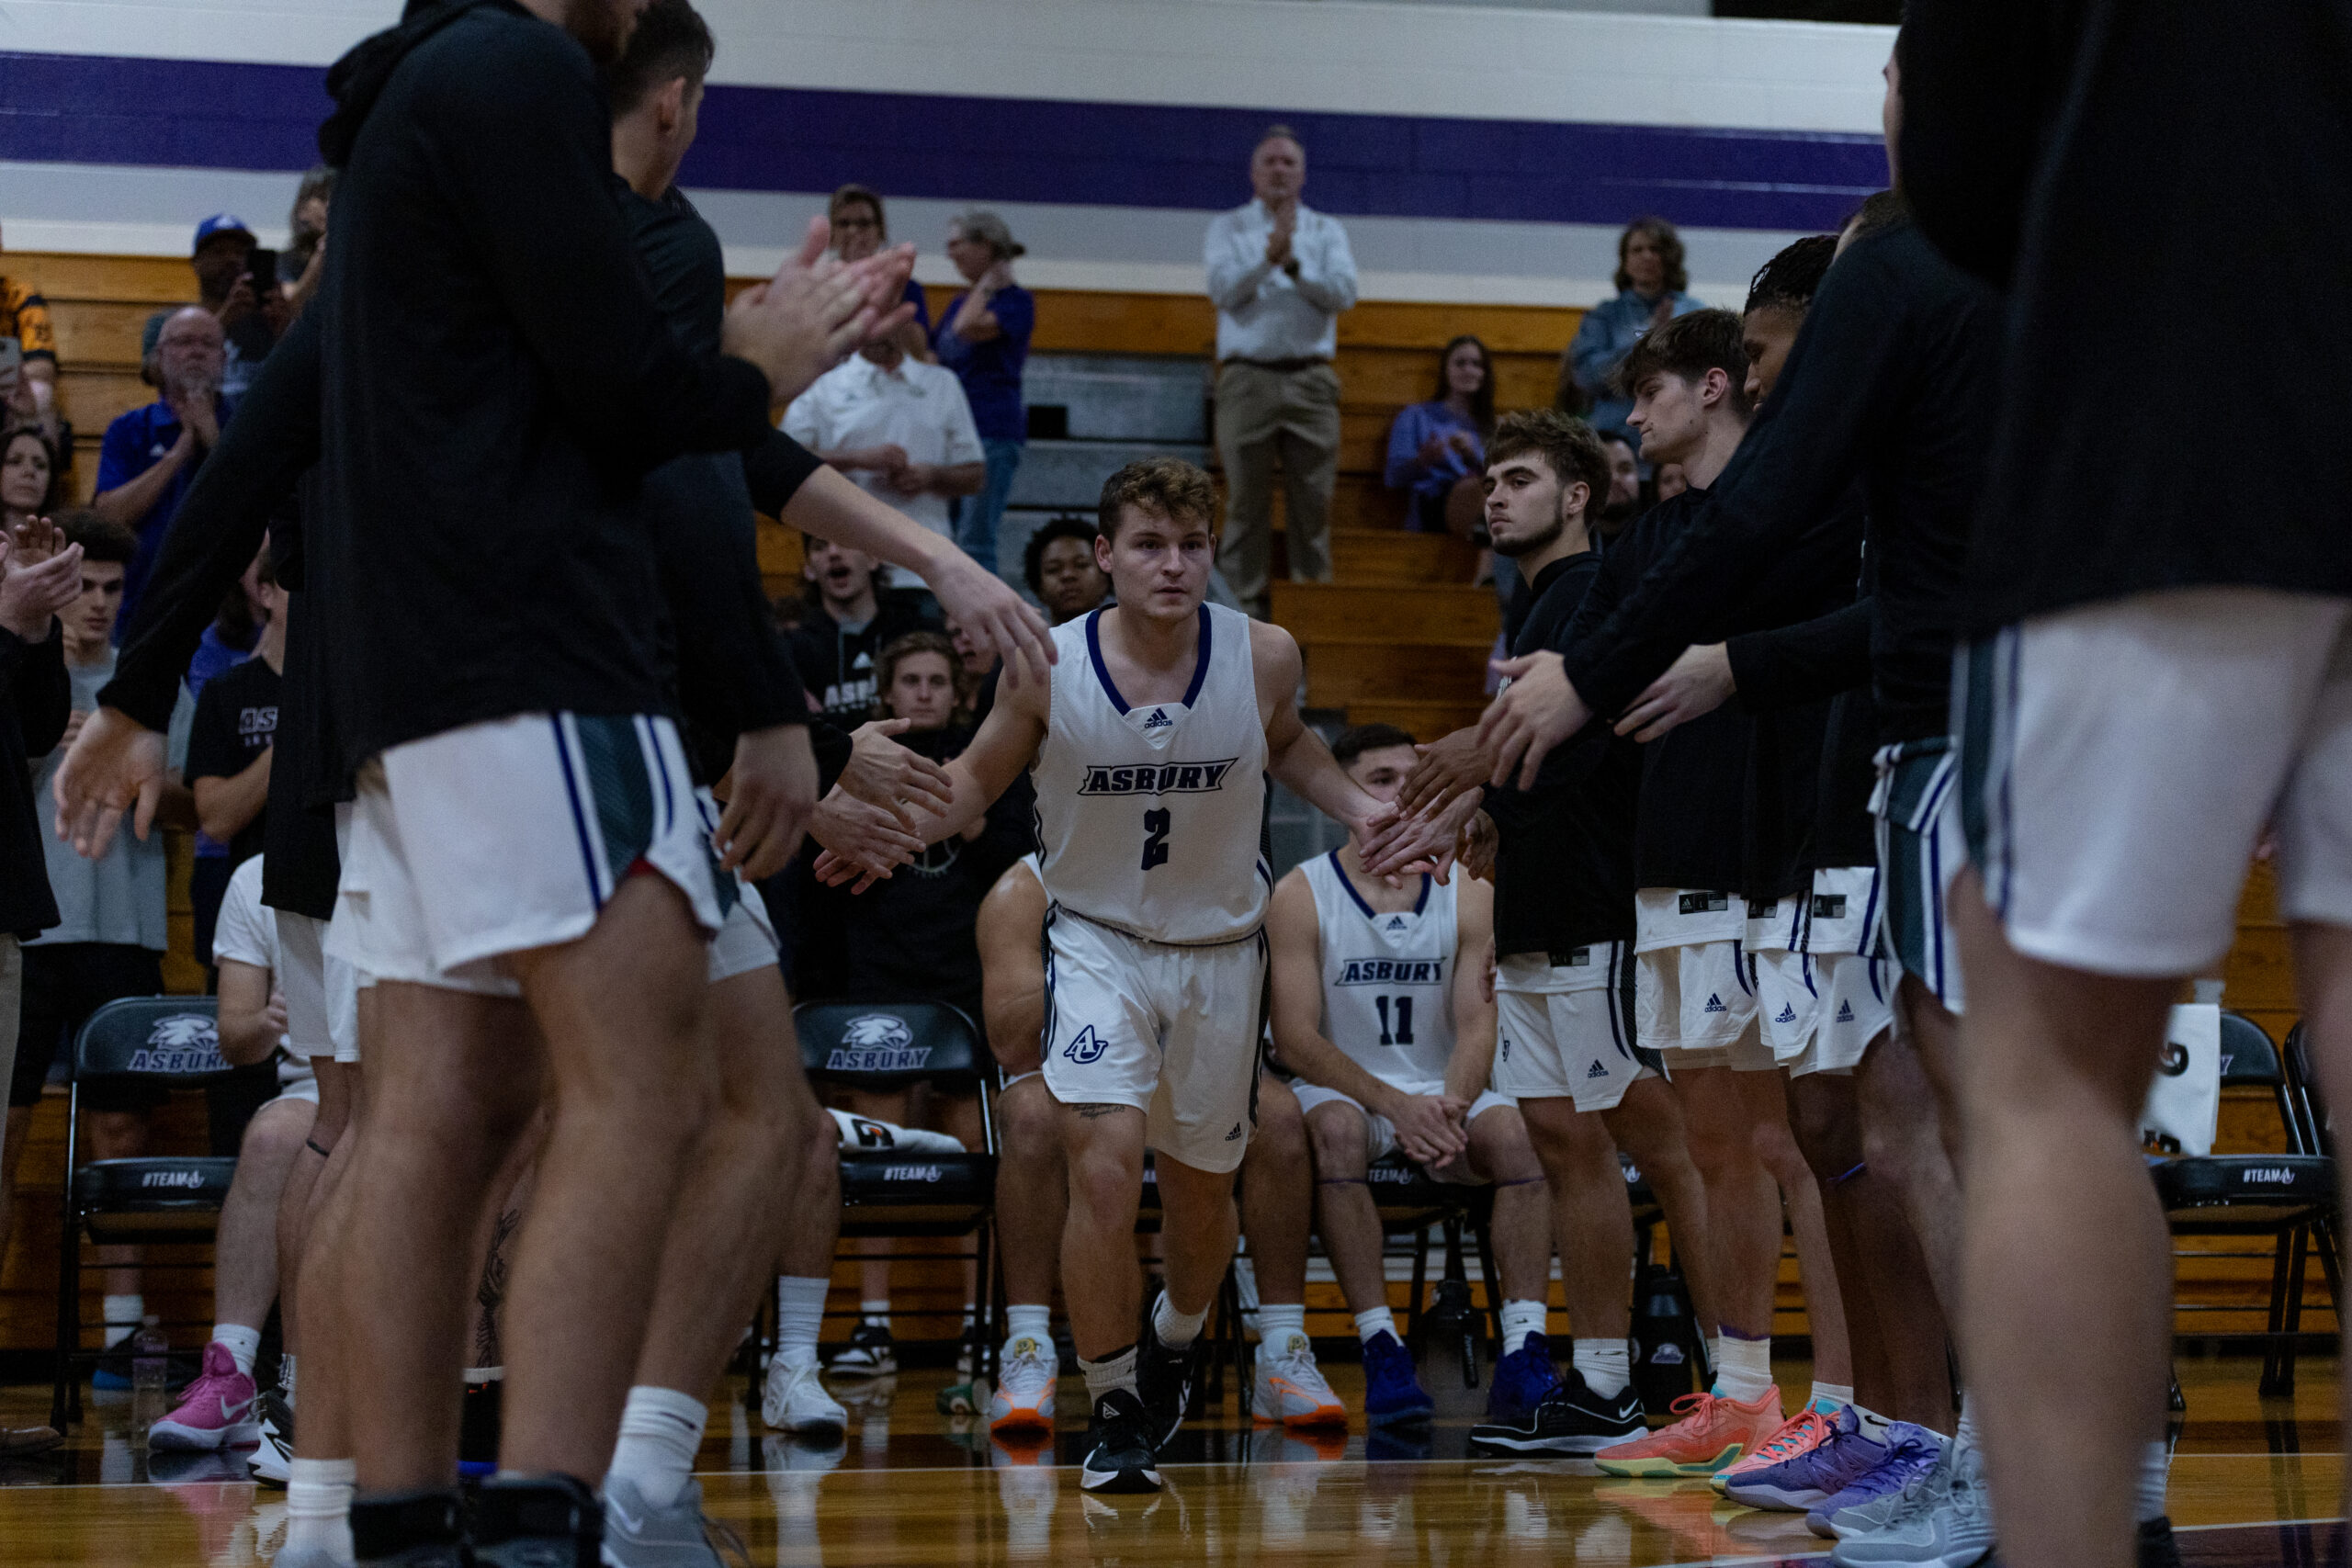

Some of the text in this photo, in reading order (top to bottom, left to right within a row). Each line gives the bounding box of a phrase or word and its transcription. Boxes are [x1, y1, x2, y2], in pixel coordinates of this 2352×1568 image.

[1144, 719, 1173, 728] adidas
[1087, 763, 1227, 792] ASBURY
[1141, 807, 1170, 871] 2
[1704, 1004, 1727, 1013] adidas
[1375, 996, 1414, 1046] 11
[128, 1049, 234, 1073] ASBUR
[826, 1046, 933, 1071] ASBURY
[1587, 1069, 1609, 1078] adidas
